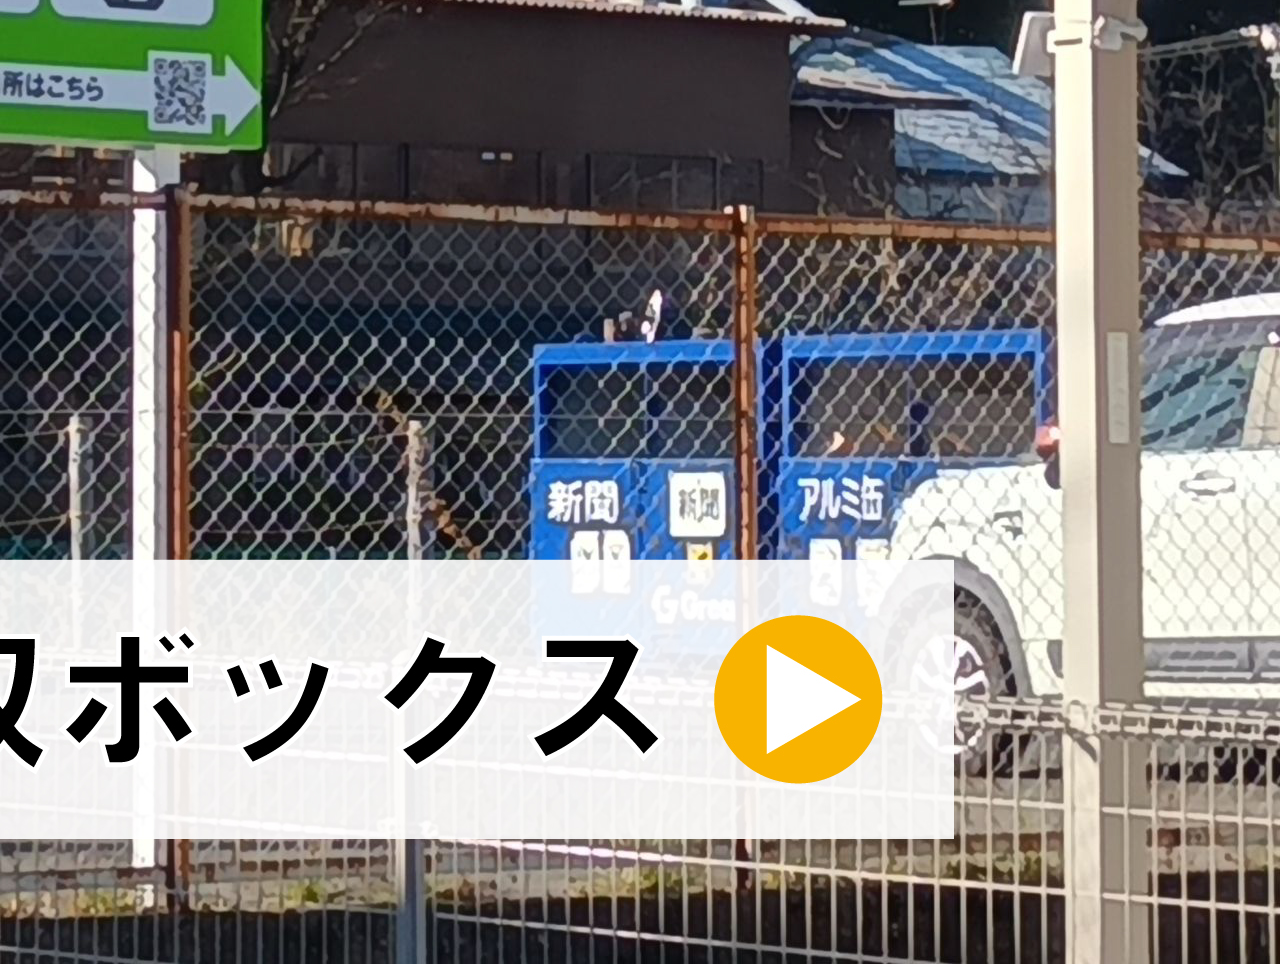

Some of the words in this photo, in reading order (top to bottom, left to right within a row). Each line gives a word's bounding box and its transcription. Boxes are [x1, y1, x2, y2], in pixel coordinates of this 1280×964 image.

[547, 479, 619, 524] 新聞
[797, 474, 885, 521] アルミ缶
